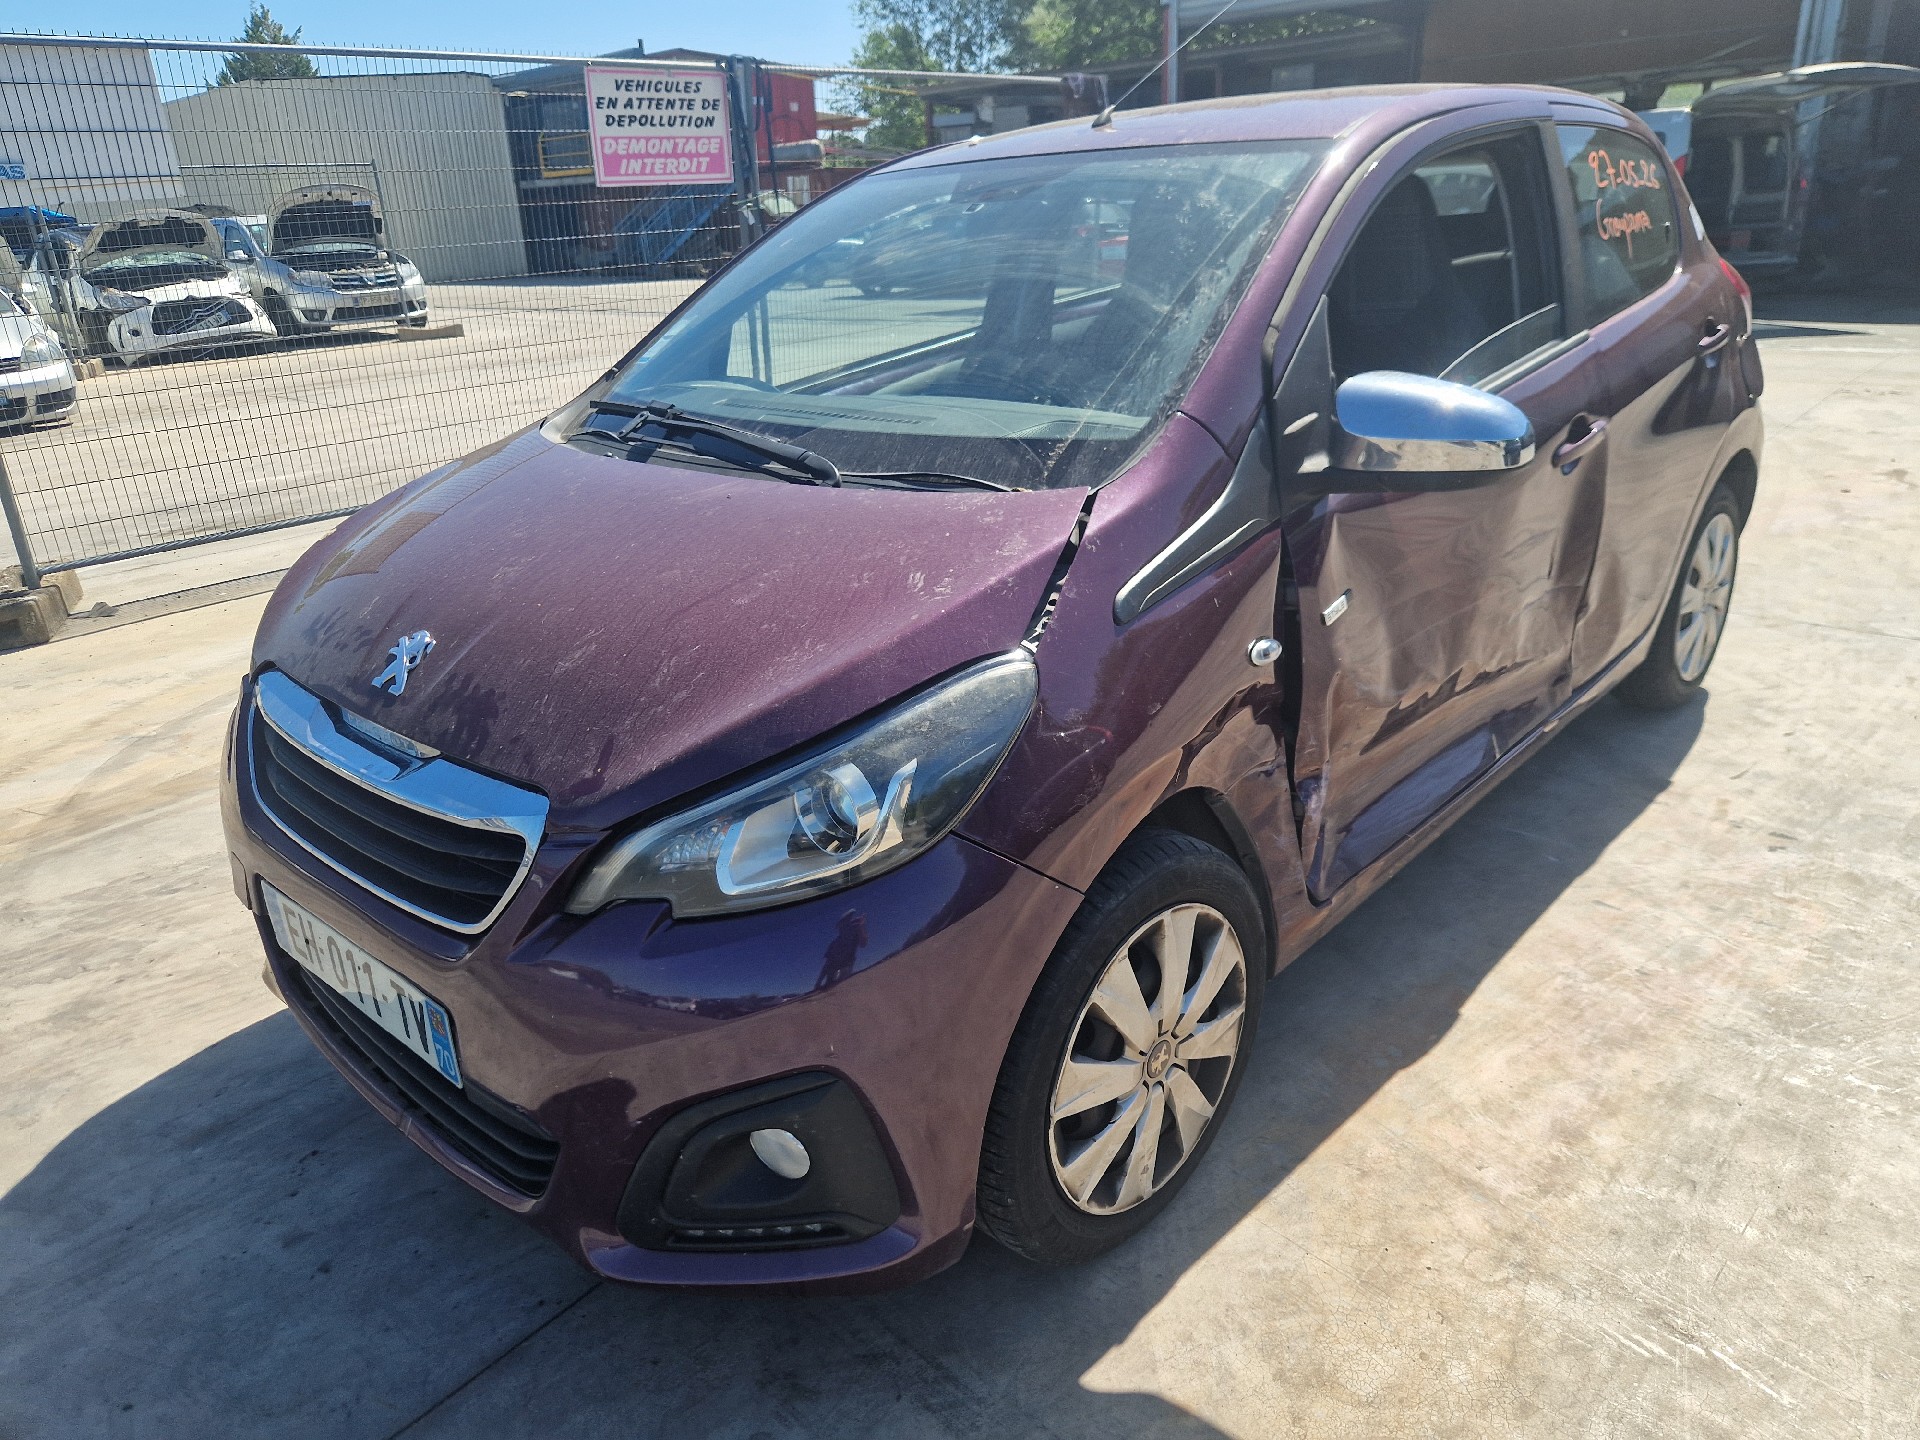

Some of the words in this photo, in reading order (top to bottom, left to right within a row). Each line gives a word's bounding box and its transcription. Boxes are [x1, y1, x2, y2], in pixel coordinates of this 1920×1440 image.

[614, 79, 702, 94] VEHICULES
[596, 96, 618, 110] EN
[623, 97, 696, 111] ATTENTE
[701, 99, 720, 111] DE
[605, 114, 715, 128] DEPOLLUTION
[602, 137, 720, 155] DEMONTAGE
[620, 157, 710, 175] INTERDIT
